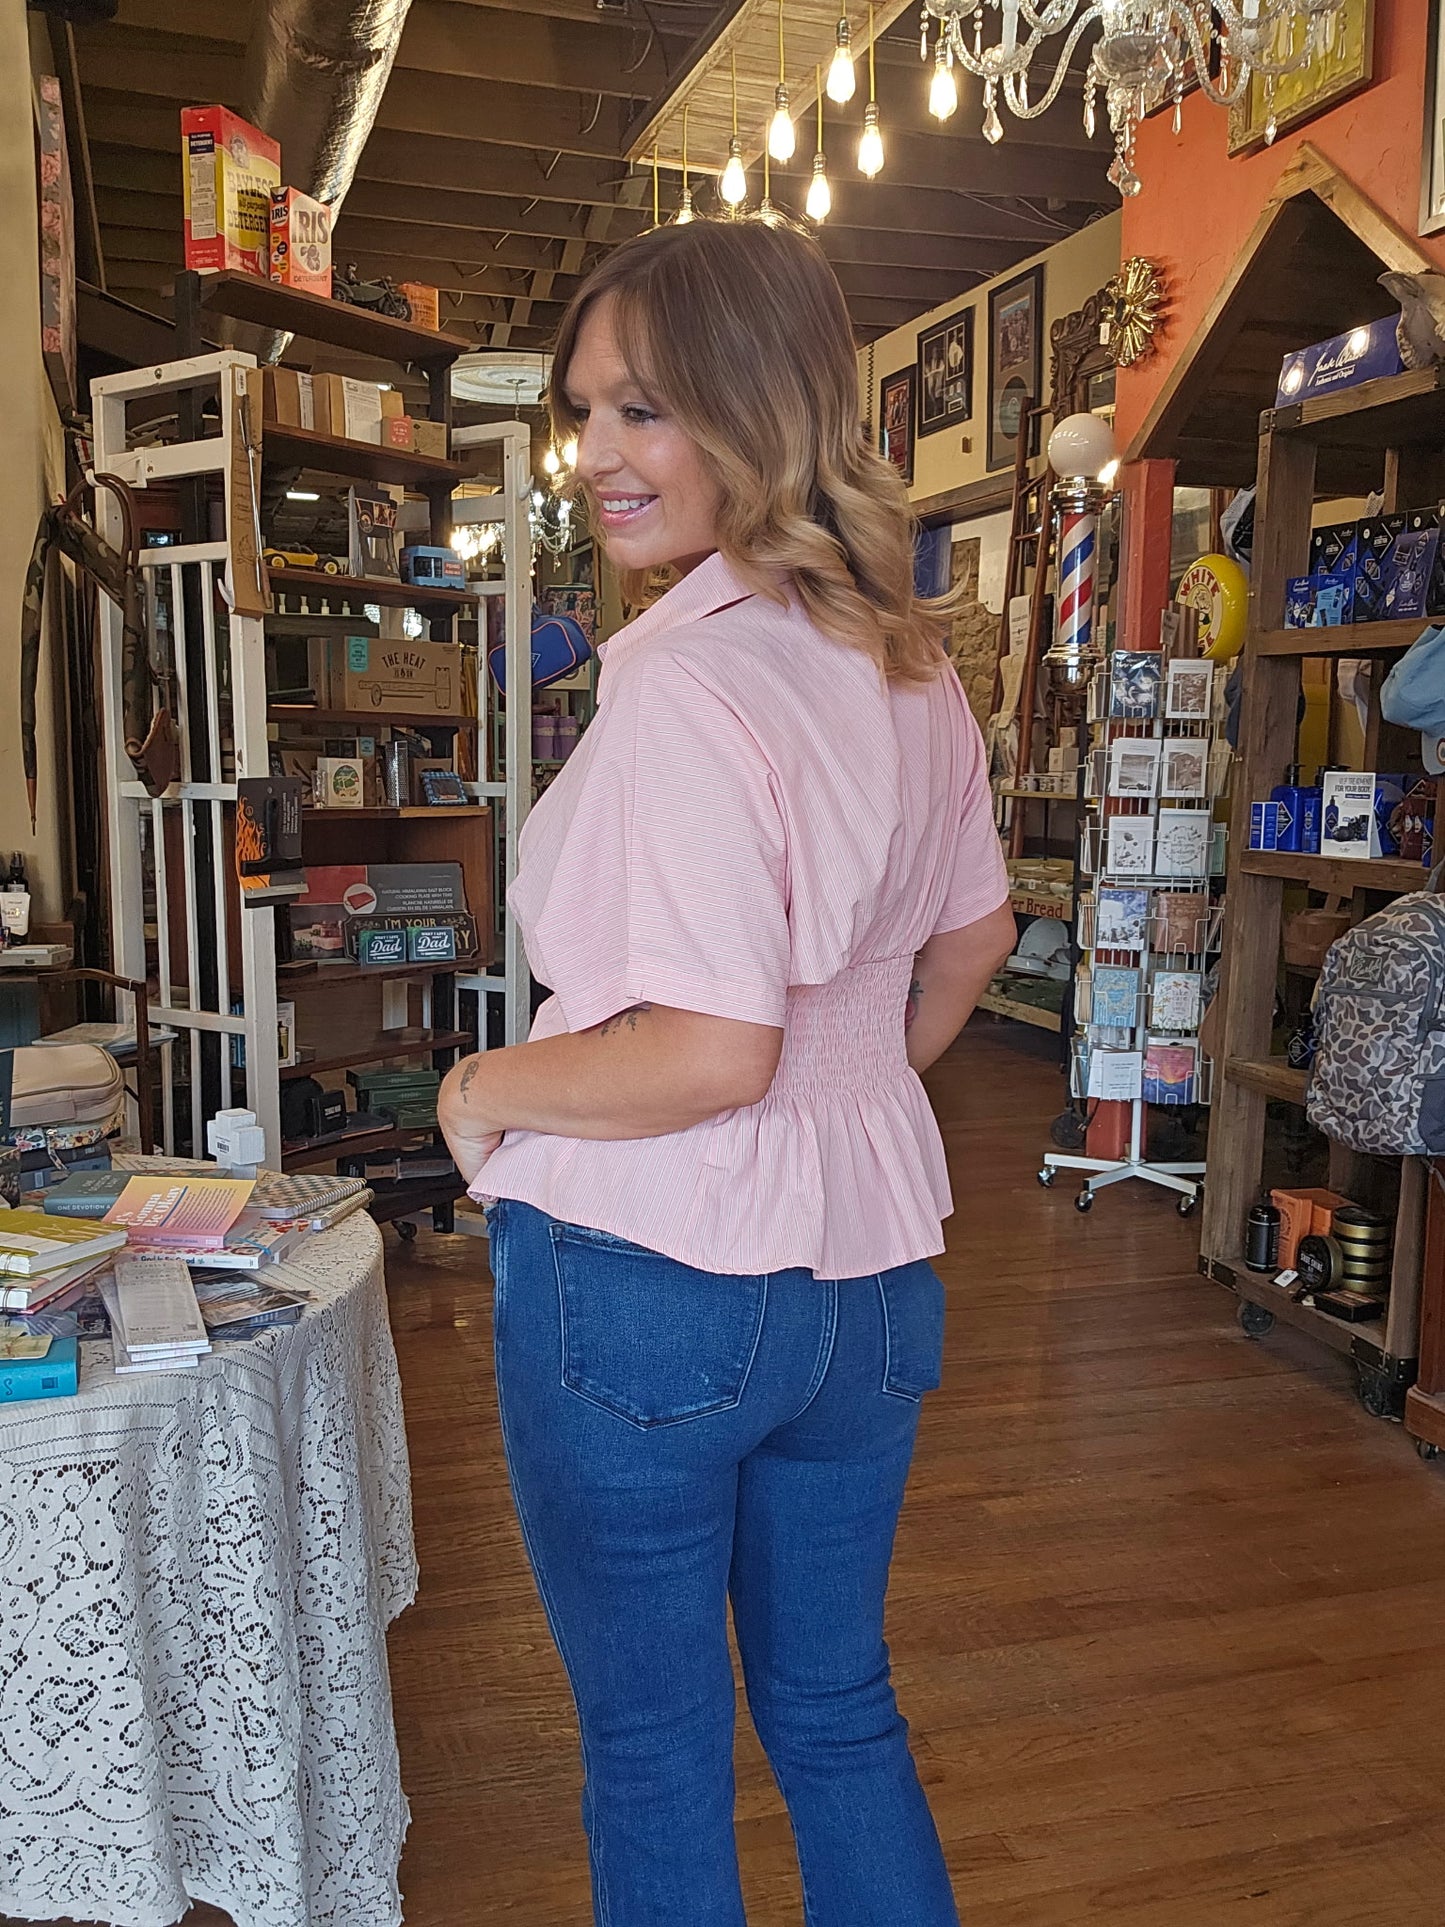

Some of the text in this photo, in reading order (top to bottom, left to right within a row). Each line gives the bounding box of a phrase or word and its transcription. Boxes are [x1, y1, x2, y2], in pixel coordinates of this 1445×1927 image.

[227, 171, 274, 199] BAYLESS
[227, 208, 269, 233] DETERGEN
[271, 205, 288, 220] IRIS
[291, 209, 329, 244] IRIS
[1308, 342, 1336, 387] Jack
[1180, 568, 1220, 597] WHITE
[382, 652, 400, 668] THE
[403, 652, 426, 670] HEAT
[1026, 898, 1063, 918] Bread
[385, 918, 437, 930] I'M YOUR
[370, 938, 402, 954] Dad
[417, 935, 451, 949] Dad
[128, 1193, 163, 1226] Gonna
[154, 1185, 181, 1213] Okay
